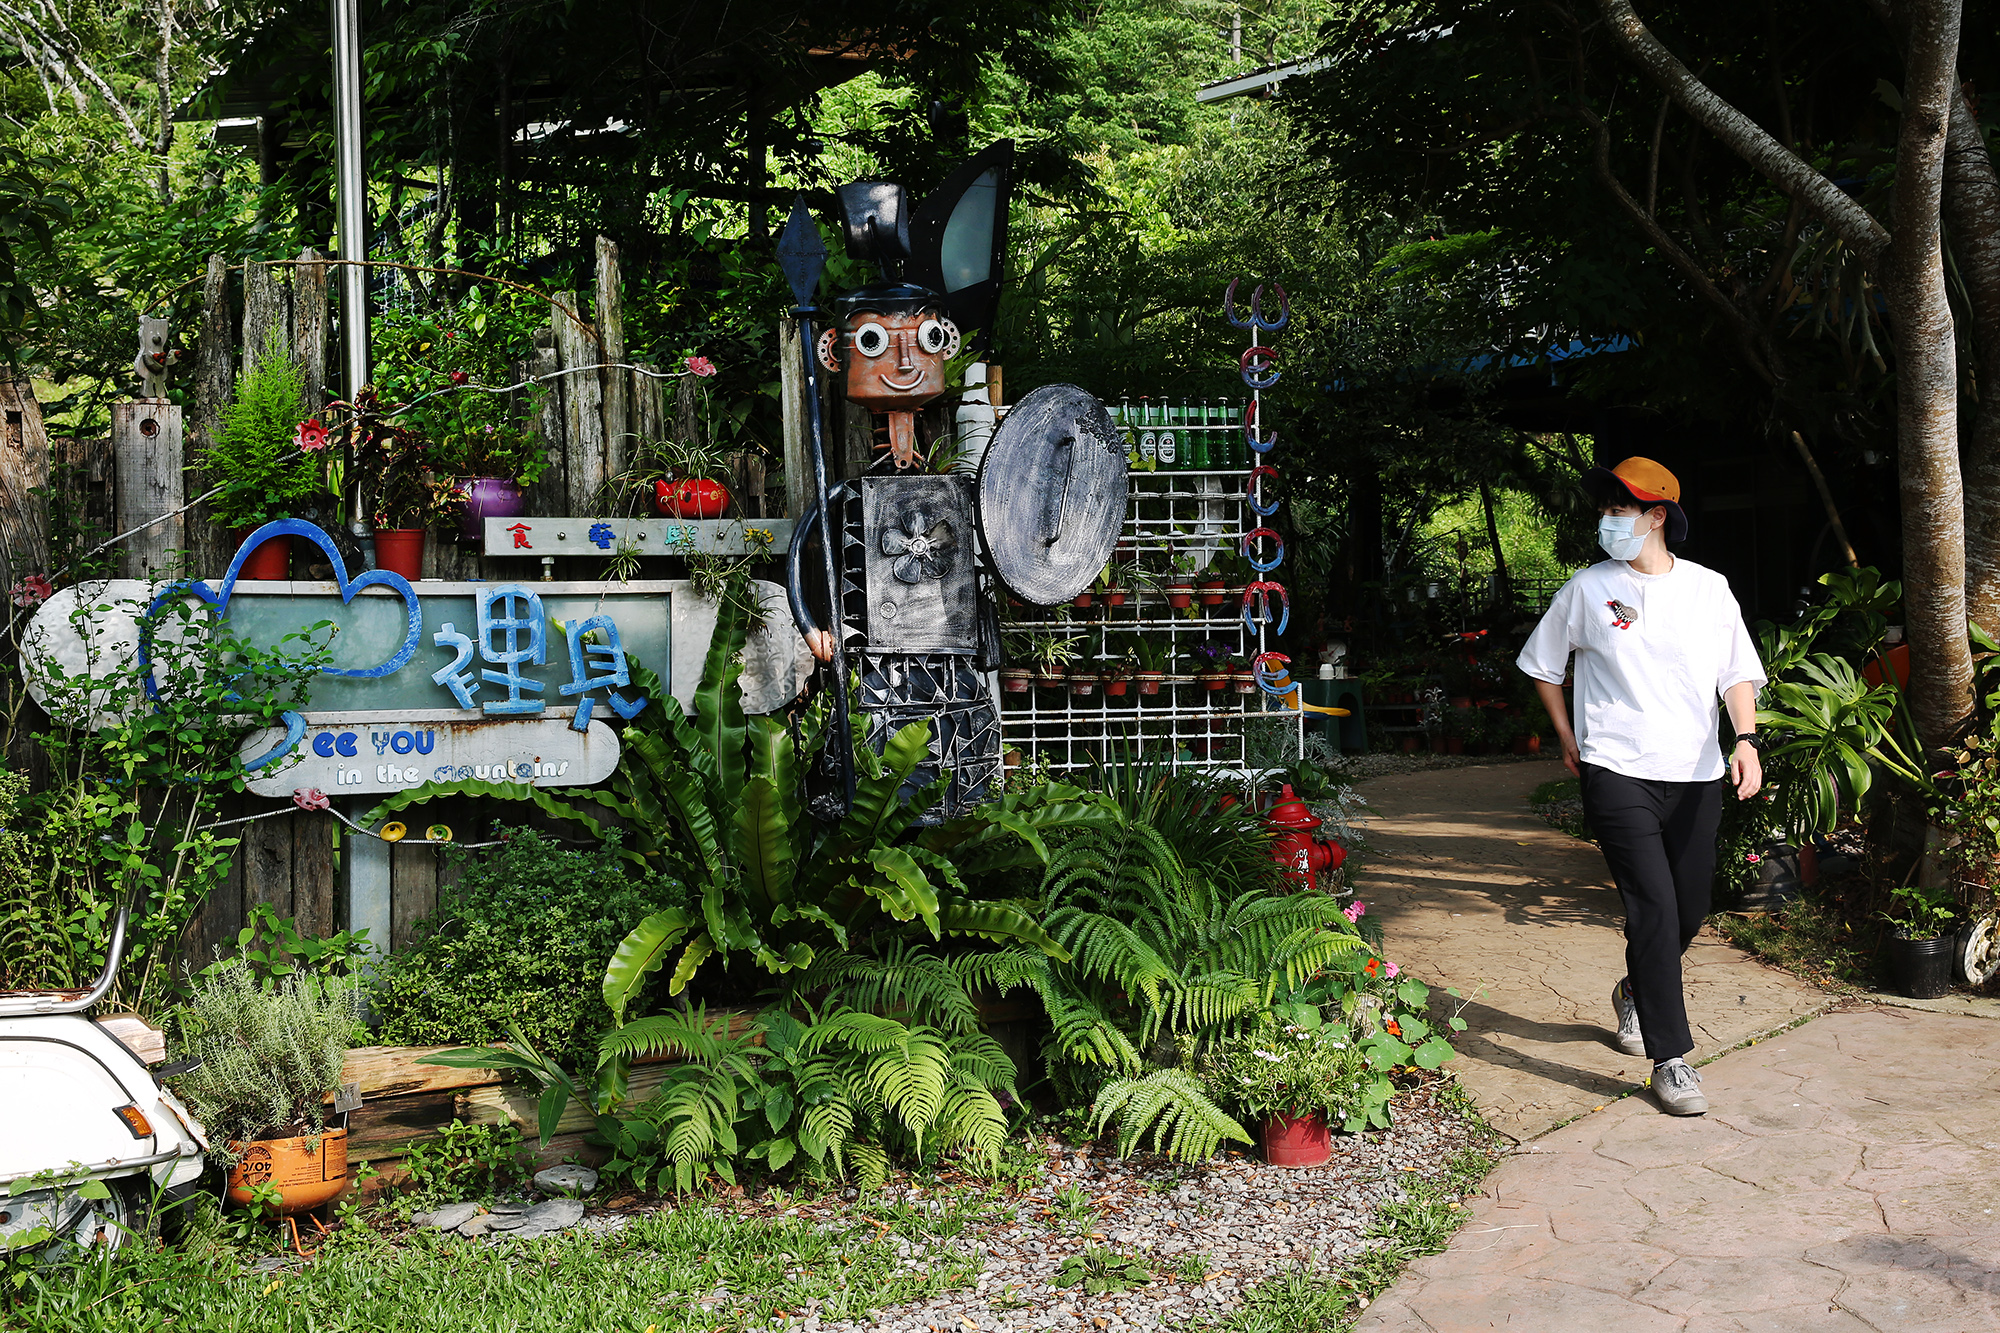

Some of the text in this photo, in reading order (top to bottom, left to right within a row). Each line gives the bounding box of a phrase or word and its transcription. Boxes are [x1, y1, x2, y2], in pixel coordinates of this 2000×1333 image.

[337, 755, 569, 786] in the mountains
